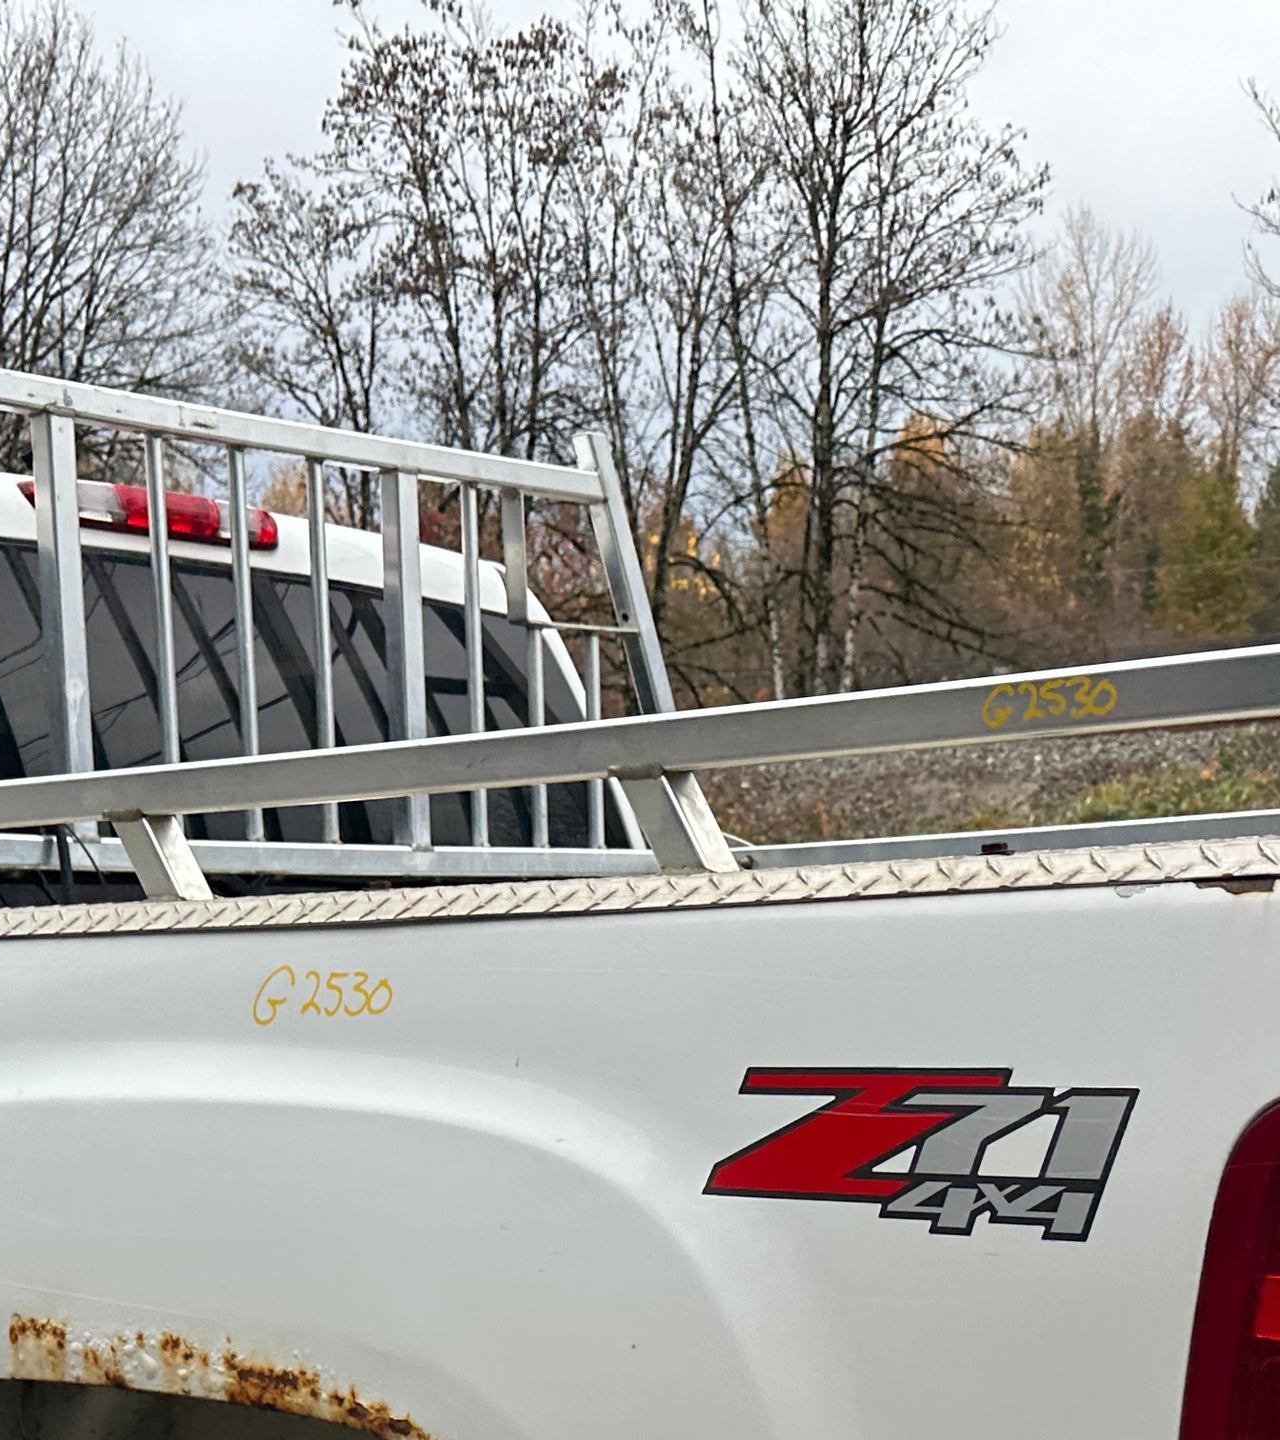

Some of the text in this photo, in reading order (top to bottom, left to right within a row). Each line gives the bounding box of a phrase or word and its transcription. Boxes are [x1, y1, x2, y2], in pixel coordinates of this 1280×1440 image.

[982, 674, 1117, 728] G2530
[252, 964, 393, 1026] G2530
[702, 1066, 1140, 1204] Z71
